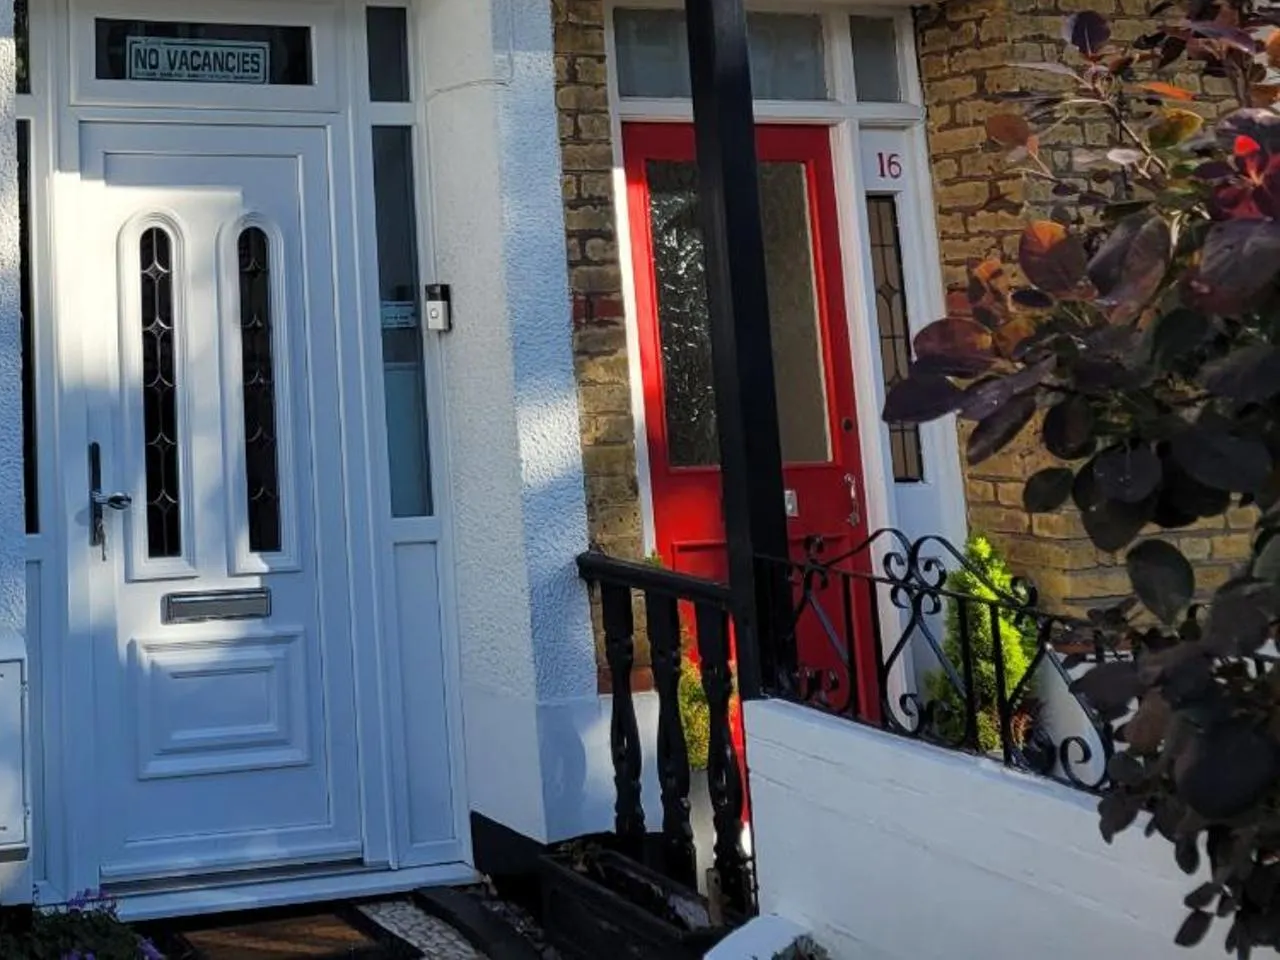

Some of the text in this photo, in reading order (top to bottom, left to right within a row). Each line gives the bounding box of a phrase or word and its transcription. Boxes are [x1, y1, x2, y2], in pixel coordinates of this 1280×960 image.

[134, 48, 261, 74] NO VACANCIES
[877, 152, 902, 179] 16
